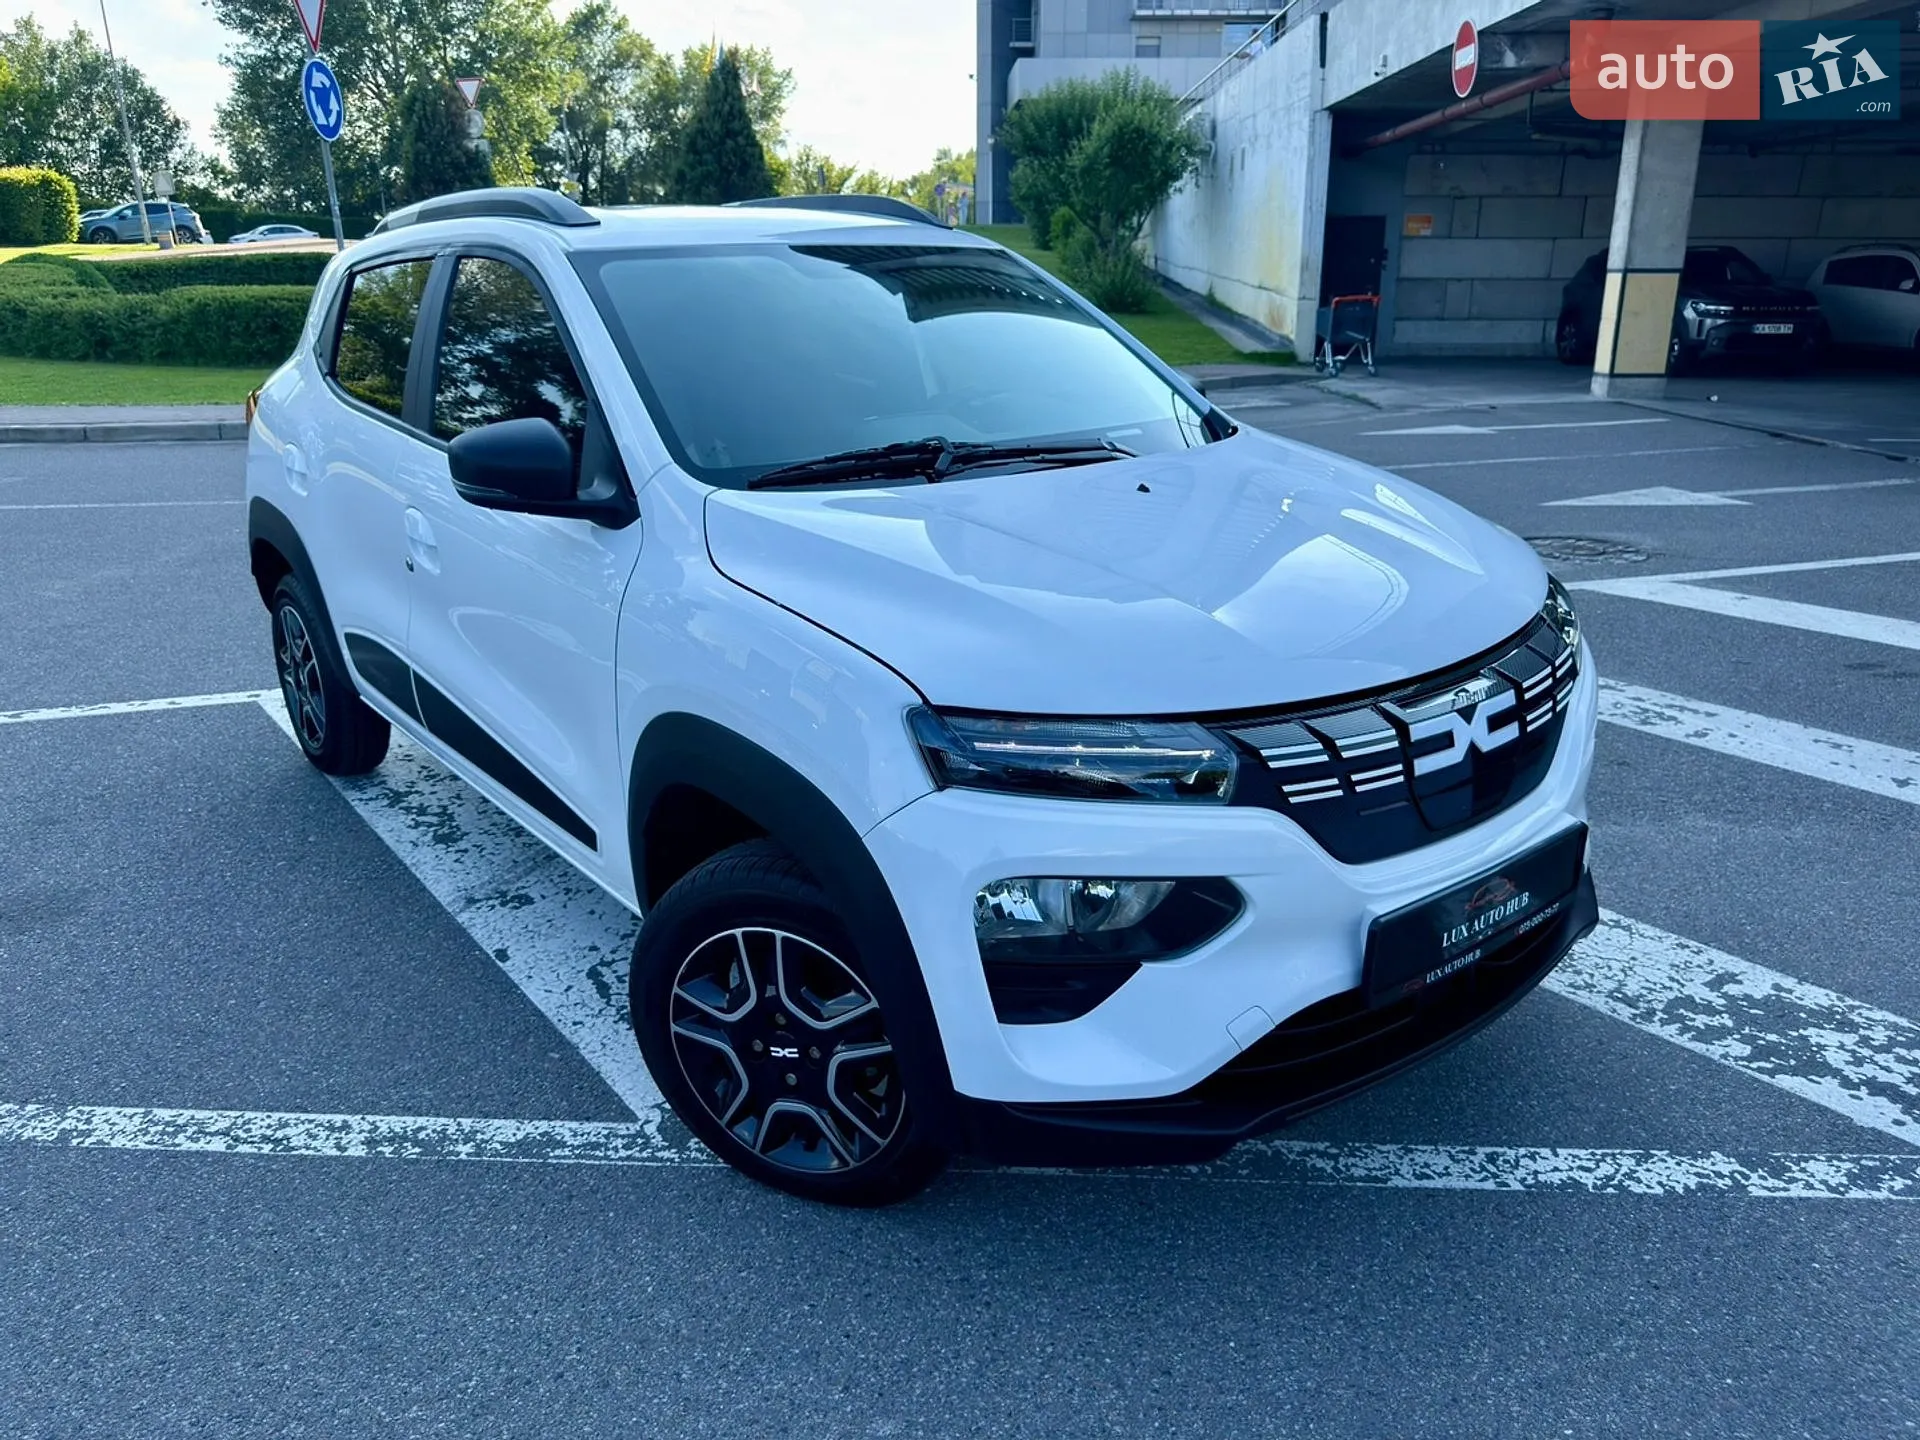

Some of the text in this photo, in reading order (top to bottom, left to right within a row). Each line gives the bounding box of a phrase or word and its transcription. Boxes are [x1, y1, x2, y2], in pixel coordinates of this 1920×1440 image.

[1441, 891, 1530, 948] LUX AUTO HUB
